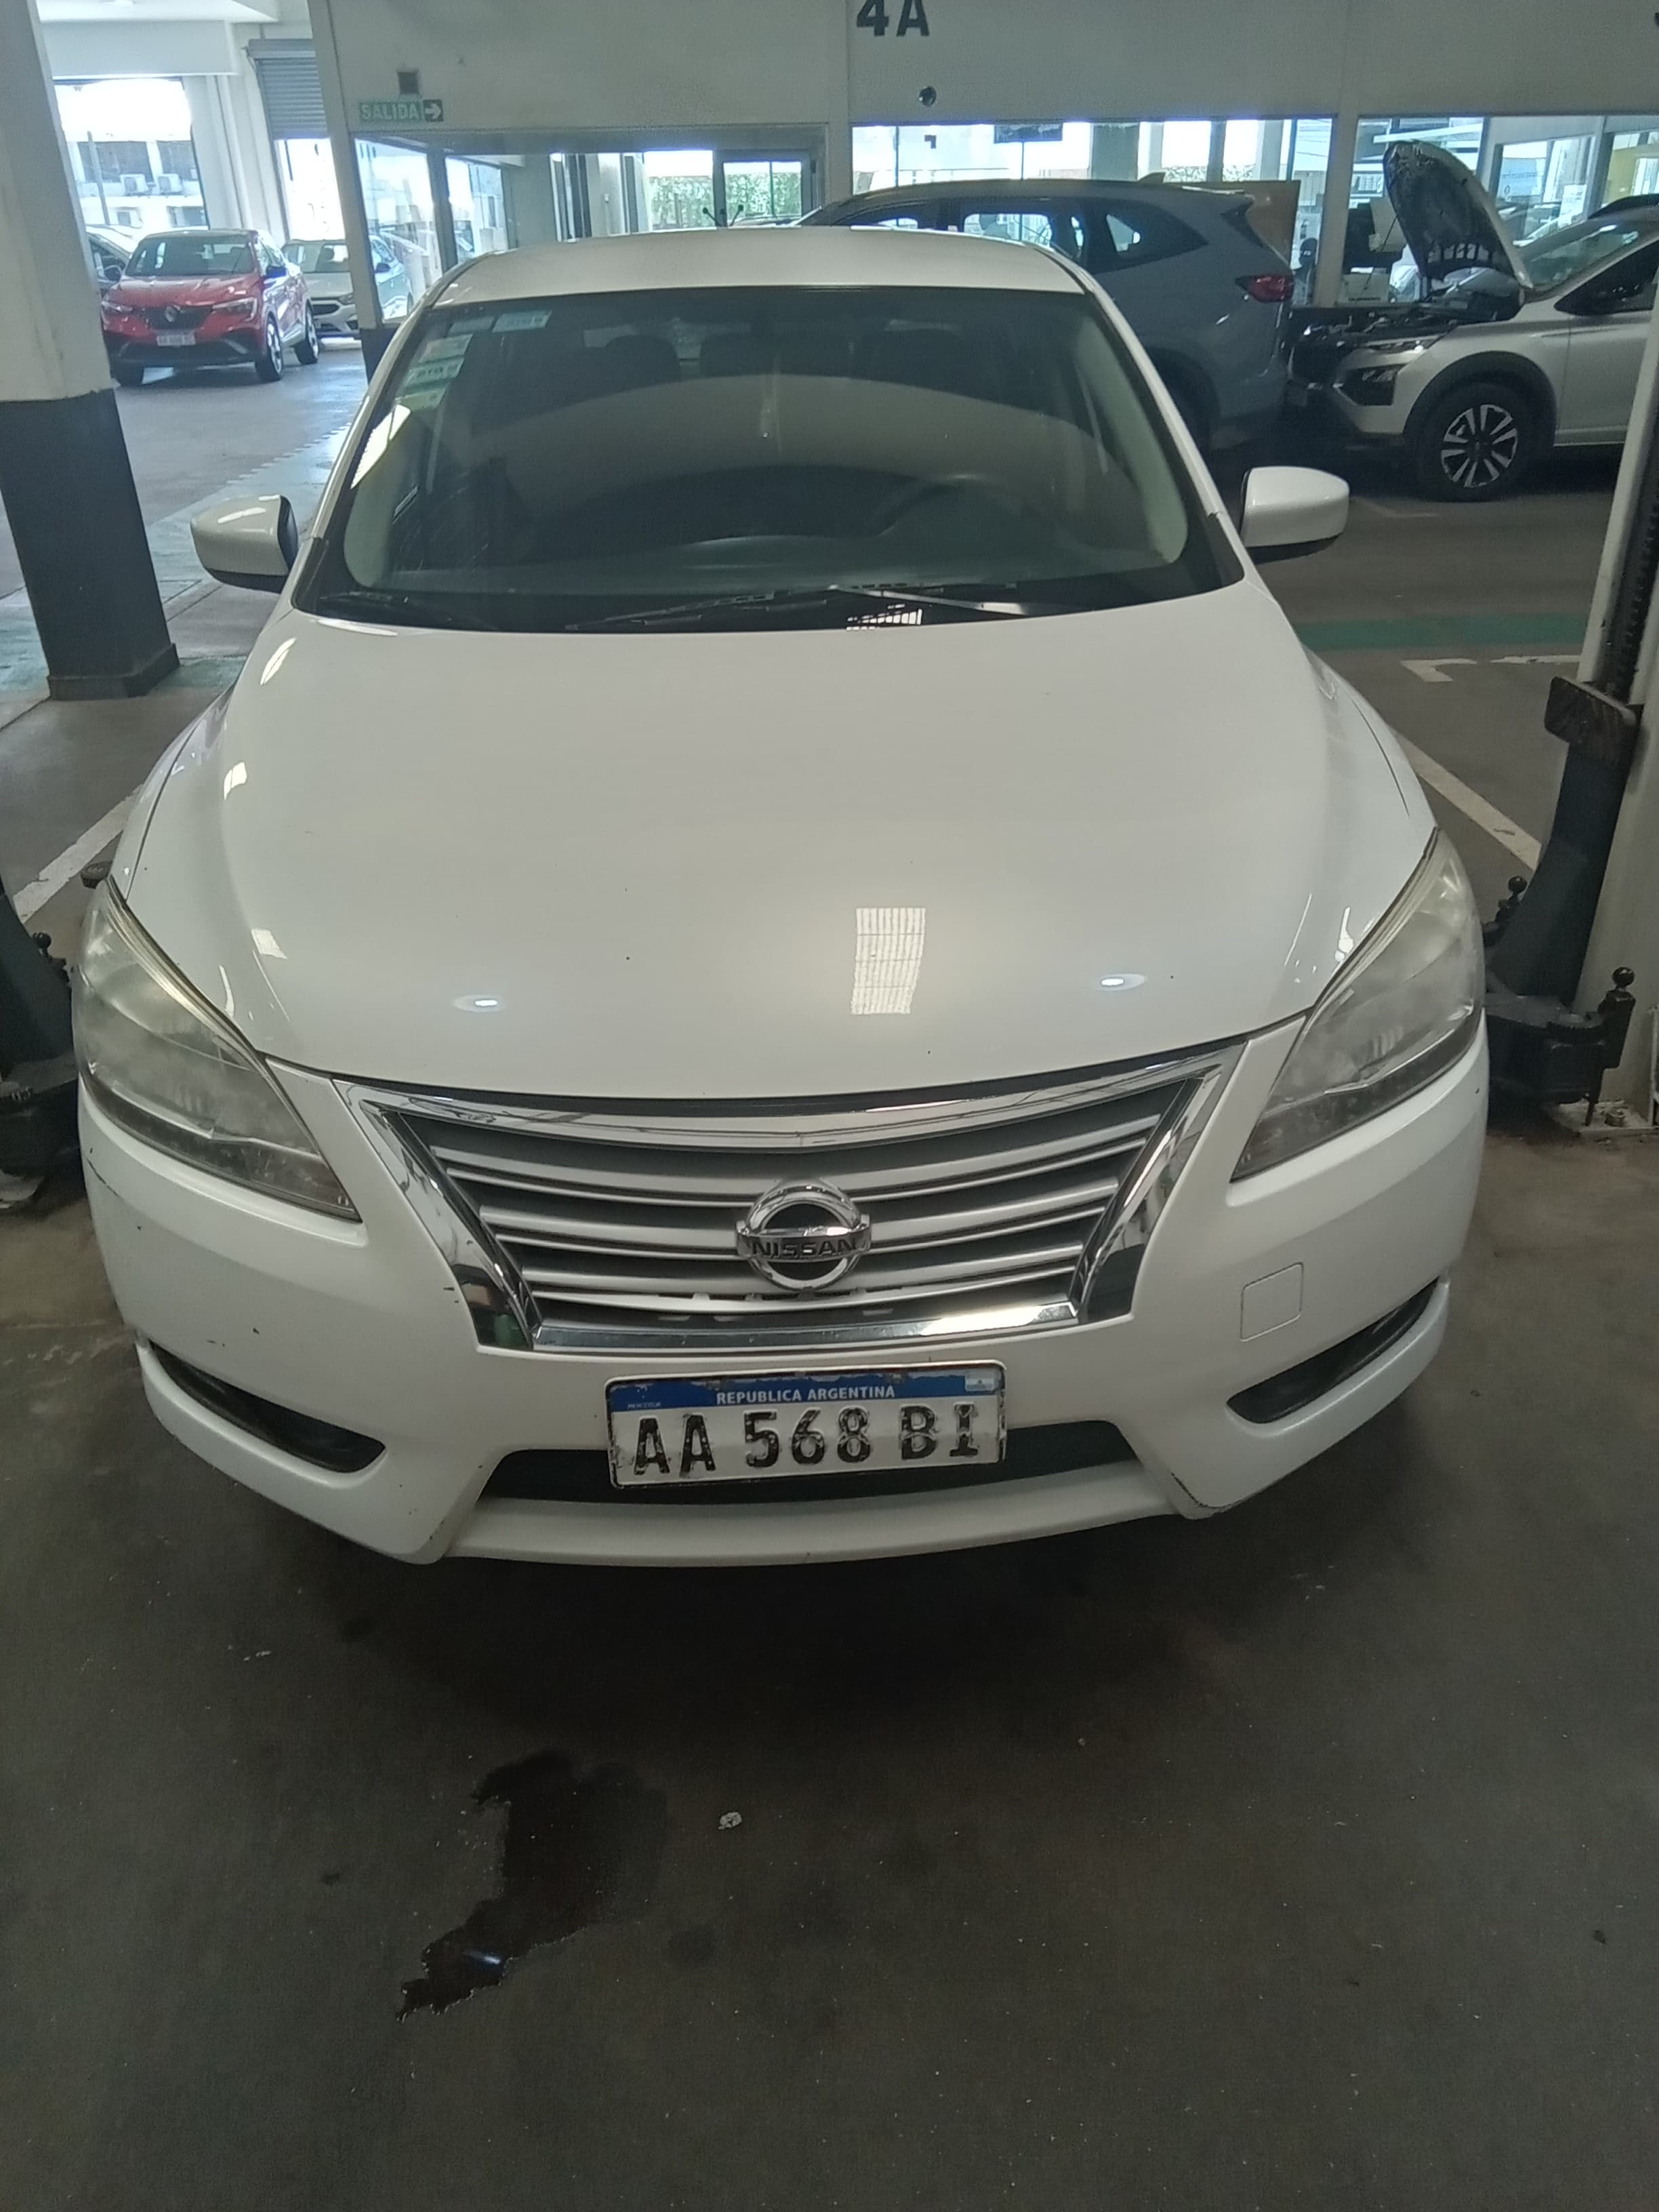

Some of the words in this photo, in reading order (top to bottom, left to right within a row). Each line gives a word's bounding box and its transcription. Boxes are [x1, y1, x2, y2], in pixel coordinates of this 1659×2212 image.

[857, 0, 929, 37] 4A
[361, 102, 419, 120] SALIDA
[753, 1239, 856, 1258] NISSAN
[716, 1389, 802, 1404] REPUBLICA
[807, 1386, 895, 1400] ARGENTINA
[634, 1413, 716, 1476] AA
[744, 1410, 870, 1467] 568
[901, 1404, 978, 1460] BI
